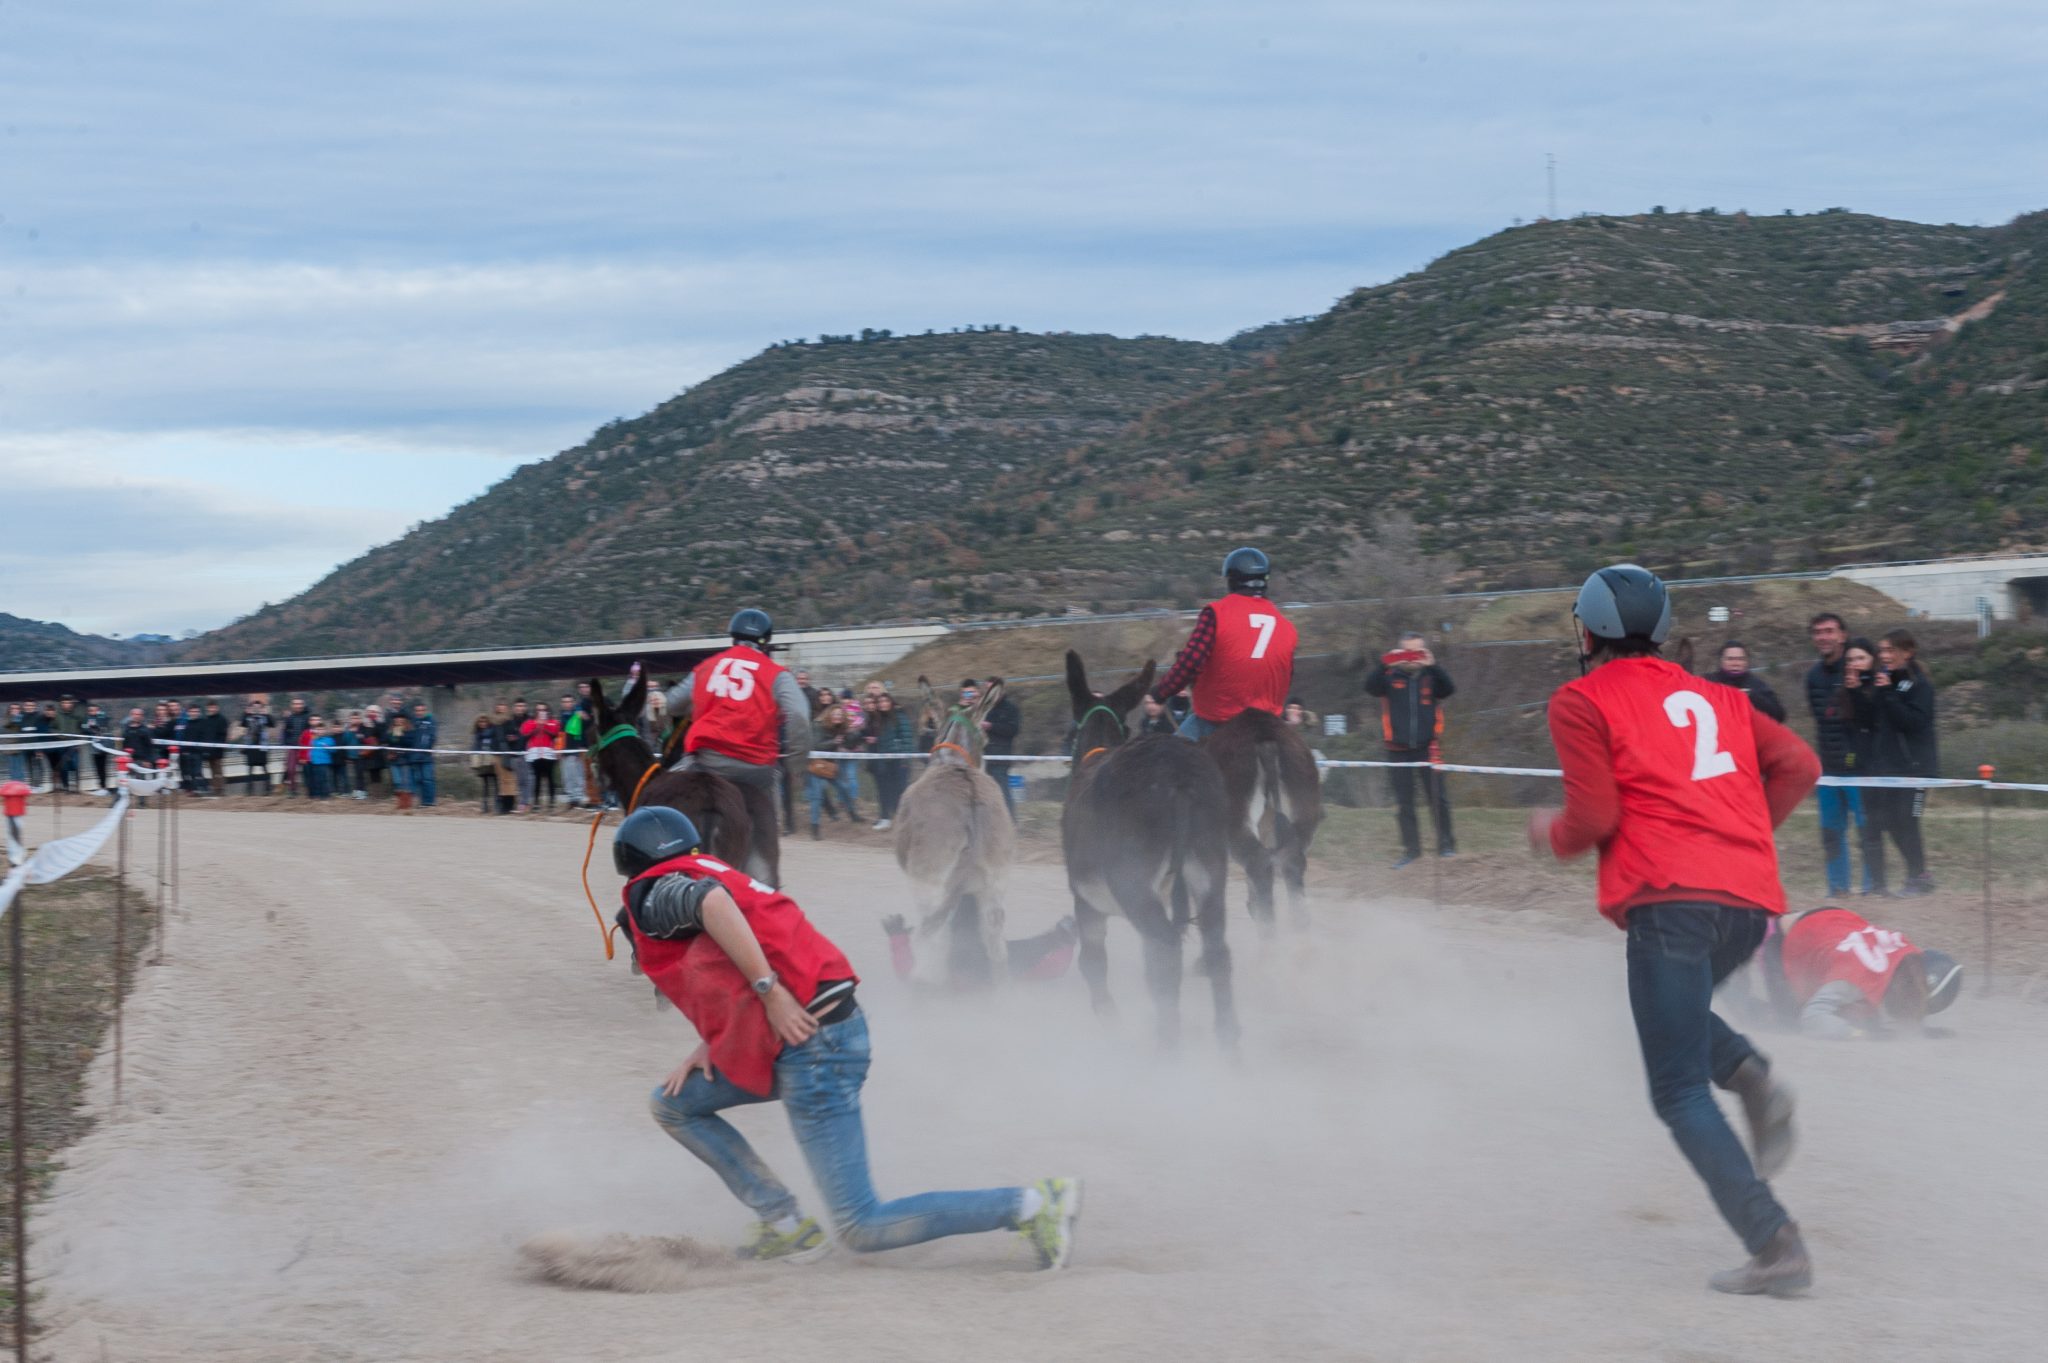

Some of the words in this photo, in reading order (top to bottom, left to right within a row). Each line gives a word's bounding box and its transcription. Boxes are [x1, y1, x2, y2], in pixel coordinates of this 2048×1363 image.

[1249, 613, 1276, 659] 7
[706, 658, 759, 701] 45
[1663, 690, 1737, 781] 2
